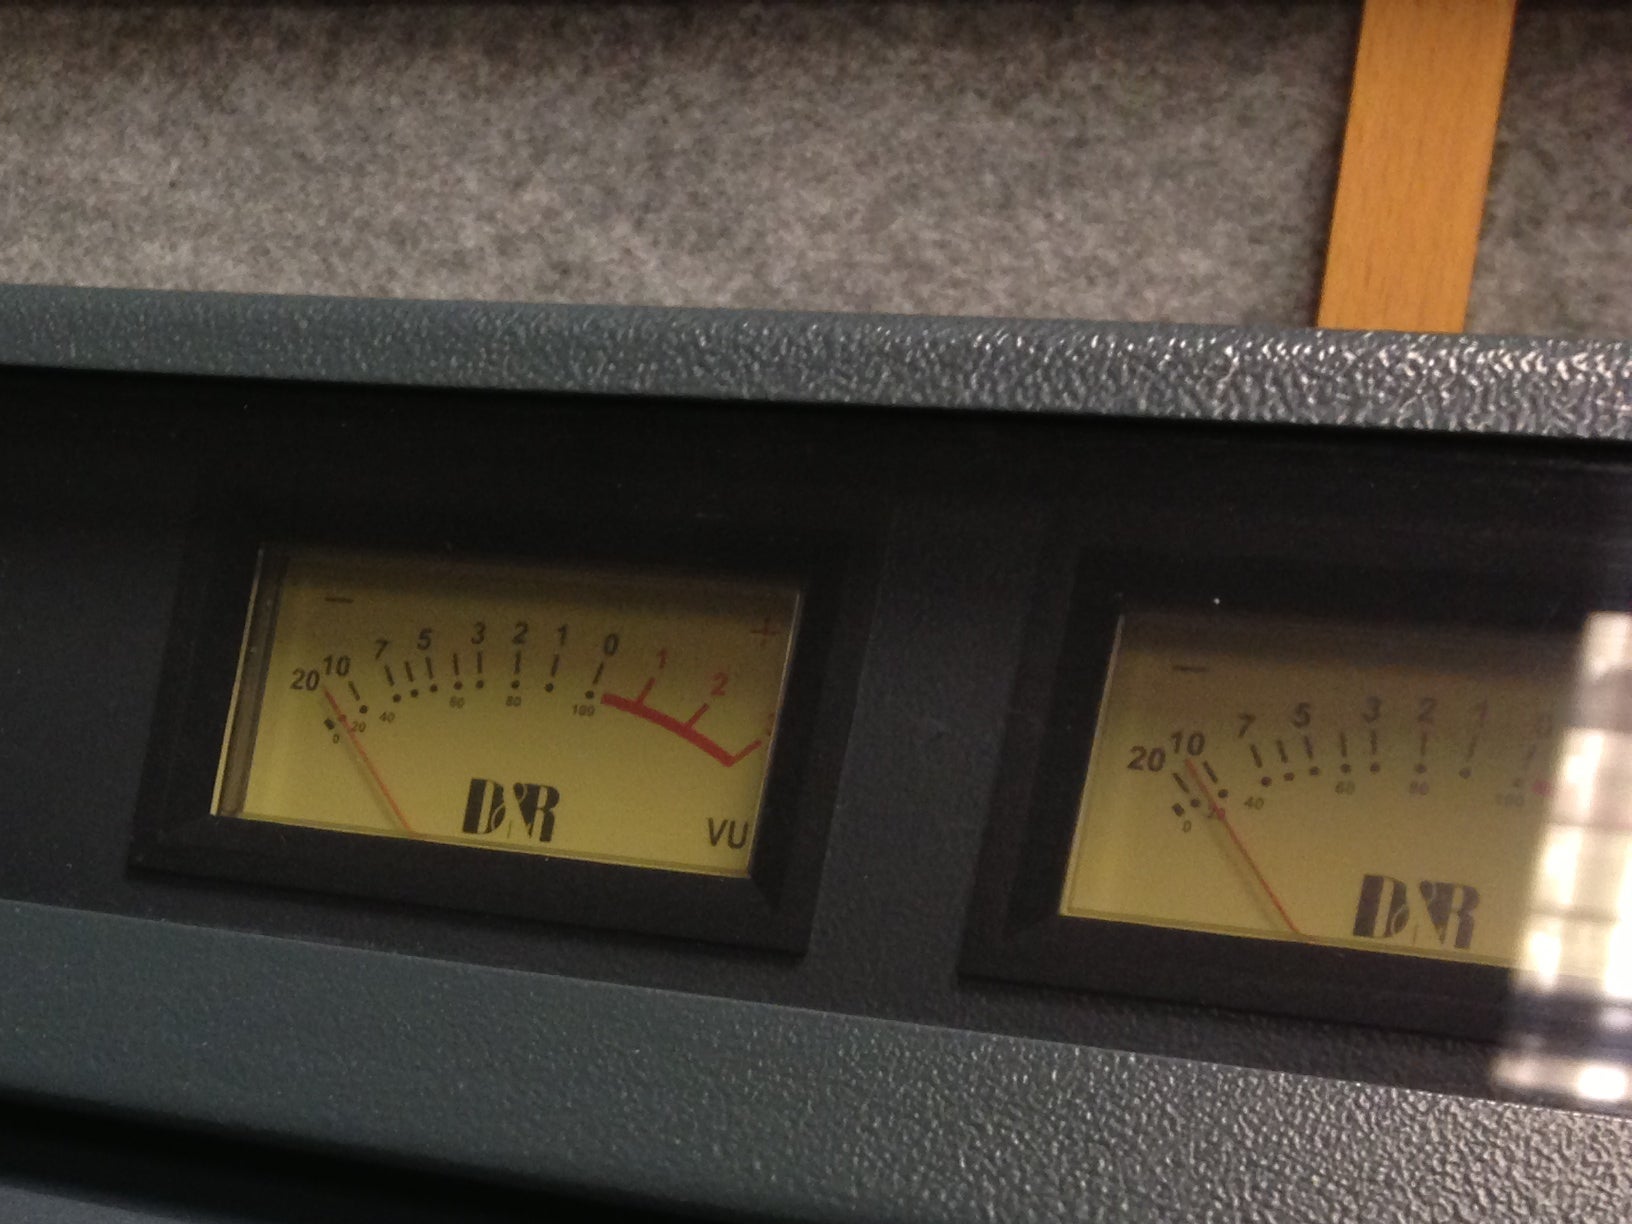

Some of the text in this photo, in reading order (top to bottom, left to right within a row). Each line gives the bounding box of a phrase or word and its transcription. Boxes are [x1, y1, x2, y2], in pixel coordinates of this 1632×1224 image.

[290, 667, 320, 692] 20
[323, 654, 351, 678] 10
[374, 638, 390, 661] 7
[416, 627, 433, 651] 5
[470, 621, 486, 645] 3
[511, 620, 530, 645] 2
[557, 623, 569, 646] 1
[603, 632, 621, 657] 0
[710, 671, 730, 696] 2
[1127, 745, 1165, 773] 20
[1170, 730, 1206, 757] 10
[1237, 714, 1256, 738] 7
[1293, 702, 1311, 728] 5
[1417, 696, 1438, 725] 2
[706, 816, 750, 850] VU
